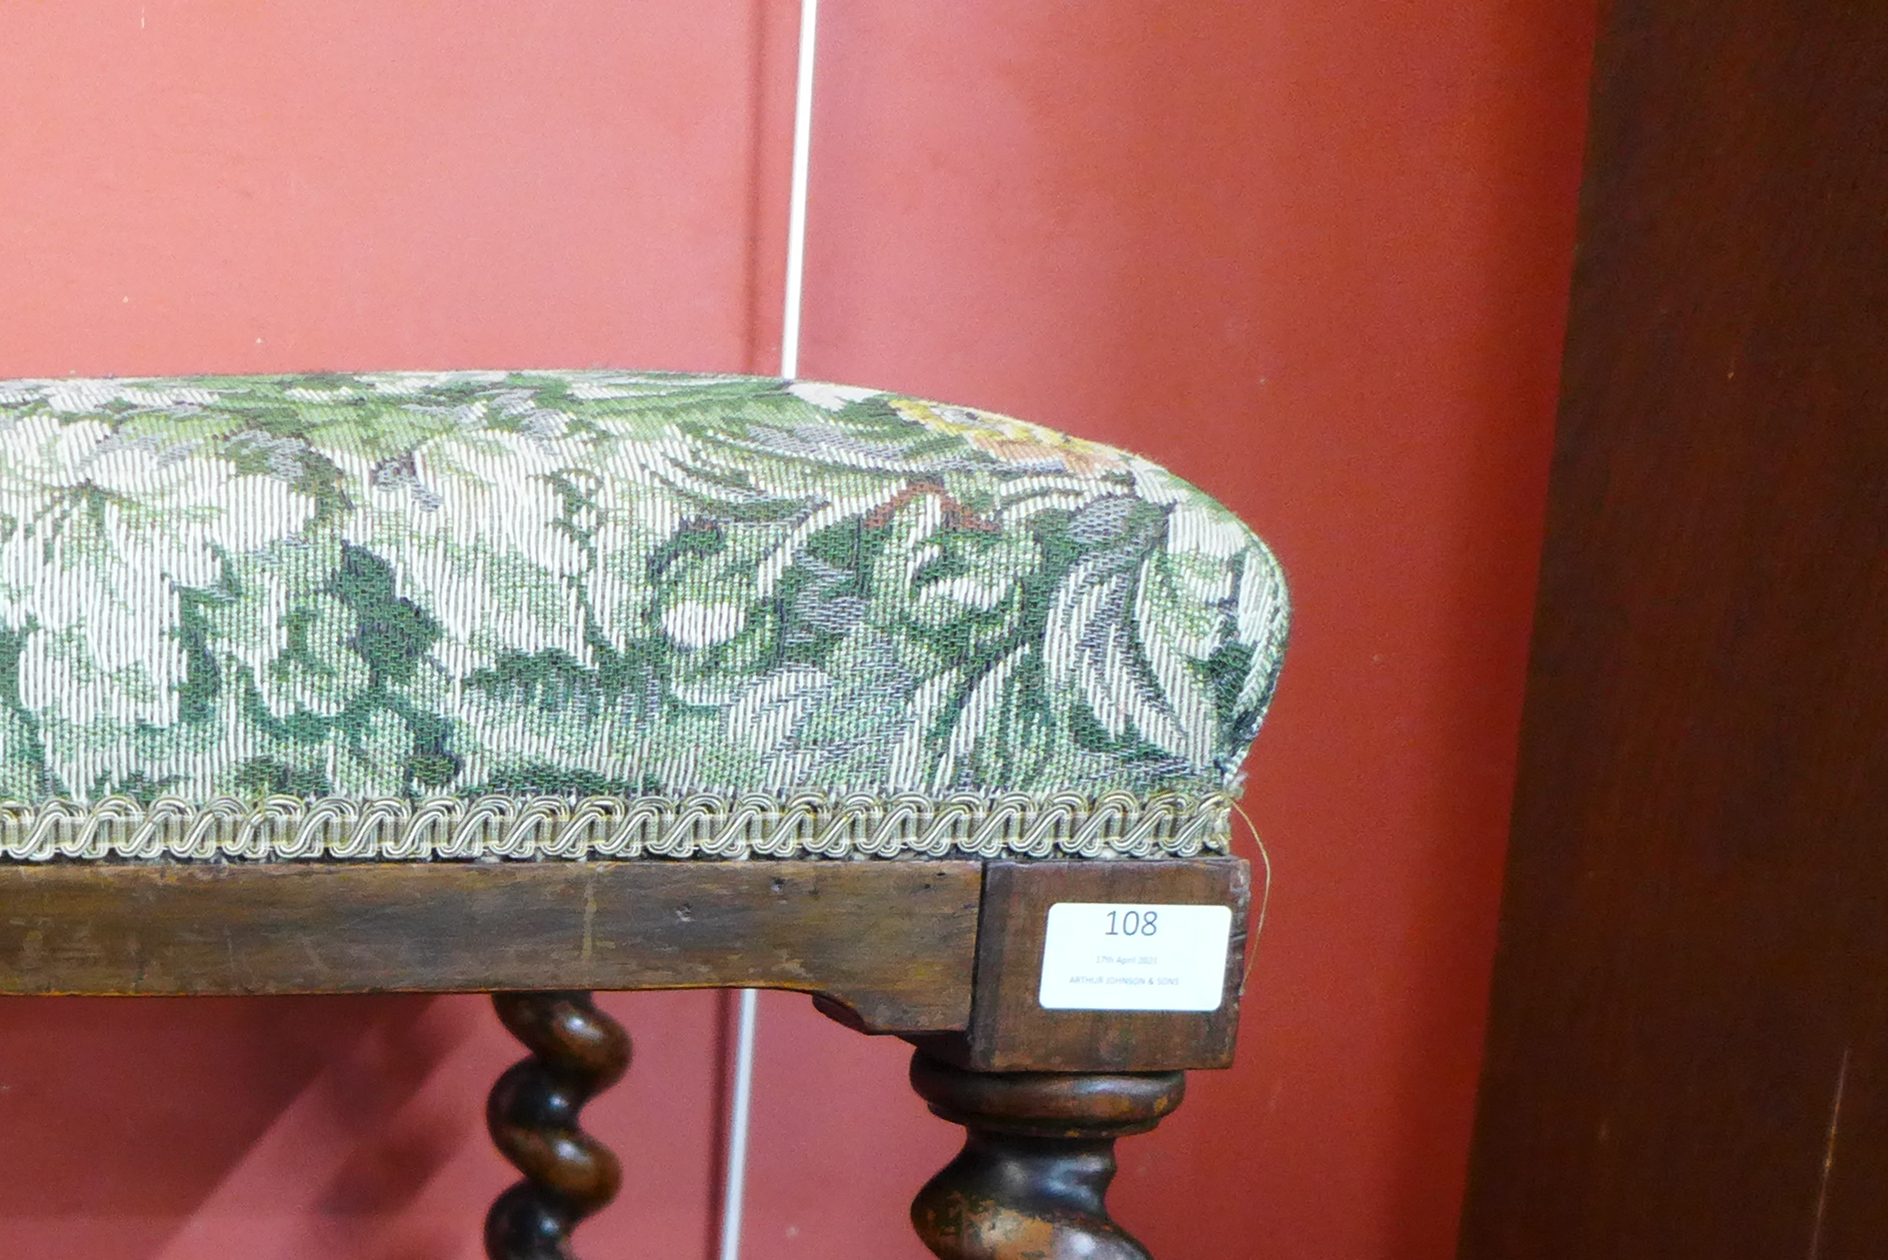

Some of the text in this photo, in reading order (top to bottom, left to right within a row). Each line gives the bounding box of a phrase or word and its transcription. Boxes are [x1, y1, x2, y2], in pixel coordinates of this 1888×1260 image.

[1105, 910, 1158, 937] 108
[1116, 955, 1136, 965] April
[1069, 975, 1180, 986] ARTHUR JOHNSON & SONS
